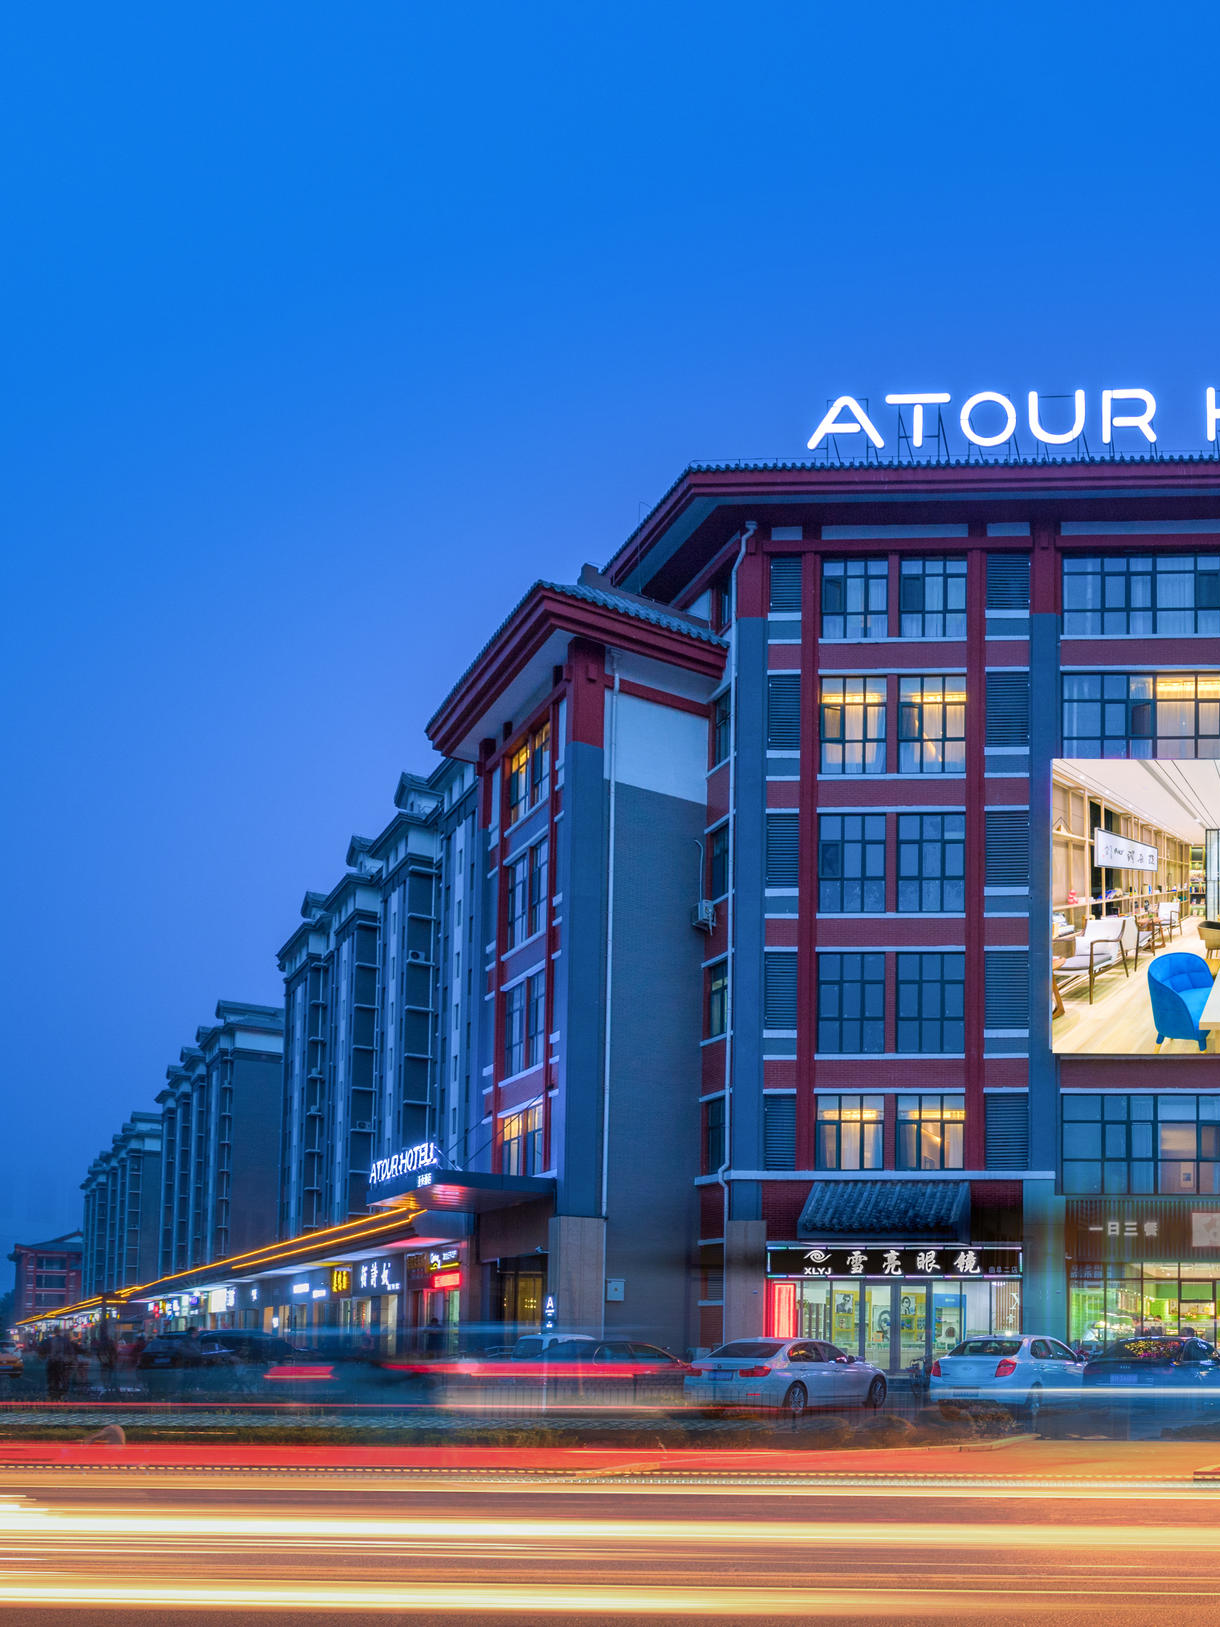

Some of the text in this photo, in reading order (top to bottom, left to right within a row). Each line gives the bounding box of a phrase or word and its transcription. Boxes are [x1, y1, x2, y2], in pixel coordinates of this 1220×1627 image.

[807, 388, 1157, 450] ATOUR
[369, 1142, 438, 1184] ATOUR HOTEL
[804, 1267, 832, 1276] XLYJ
[846, 1250, 981, 1275] 雪亮眼镜
